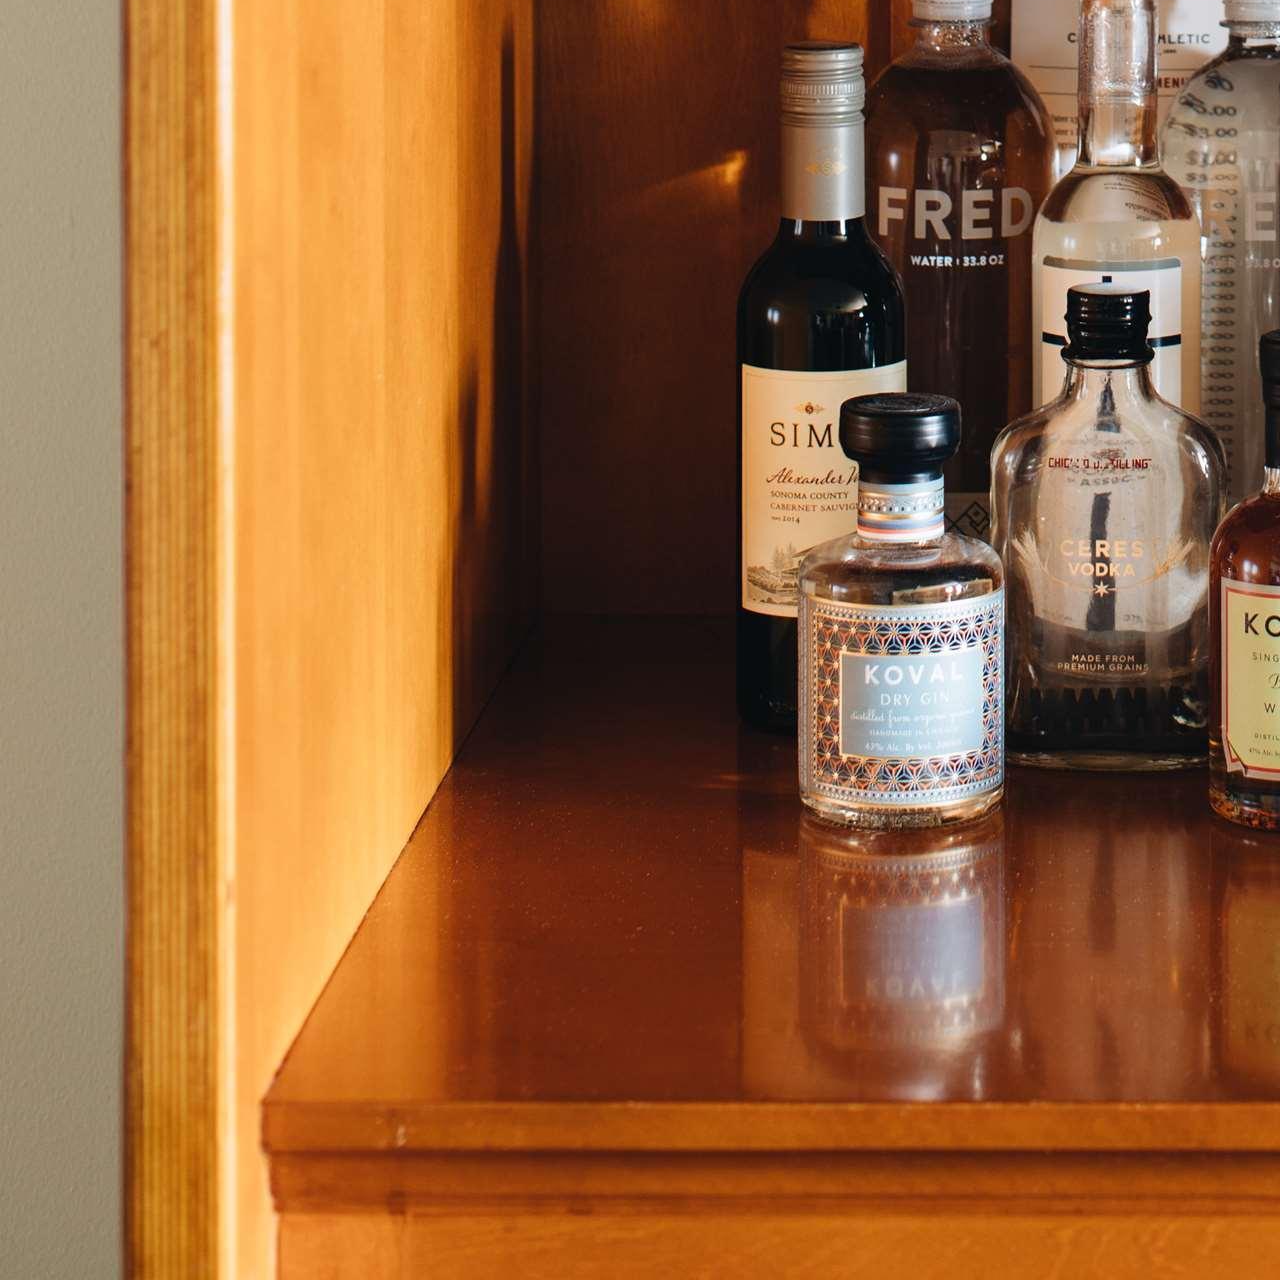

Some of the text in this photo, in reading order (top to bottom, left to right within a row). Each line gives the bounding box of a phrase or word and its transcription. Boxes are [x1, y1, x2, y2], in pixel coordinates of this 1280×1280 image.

[1157, 33, 1210, 45] HLETIC
[878, 186, 1034, 241] FRED
[910, 255, 1005, 268] WATER 33.8 OZ
[769, 421, 836, 449] SIM
[766, 466, 846, 486] Alexander
[770, 490, 849, 500] SONOMA COUNTY
[770, 502, 860, 513] CABERNET SAUVIG
[1060, 539, 1145, 558] CERES
[1068, 562, 1136, 578] VODKA
[1071, 654, 1136, 663] MADE FROM
[864, 662, 963, 686] KOVAL
[1057, 662, 1150, 672] PREMIUM GRAINS
[880, 692, 950, 706] DRY GIN
